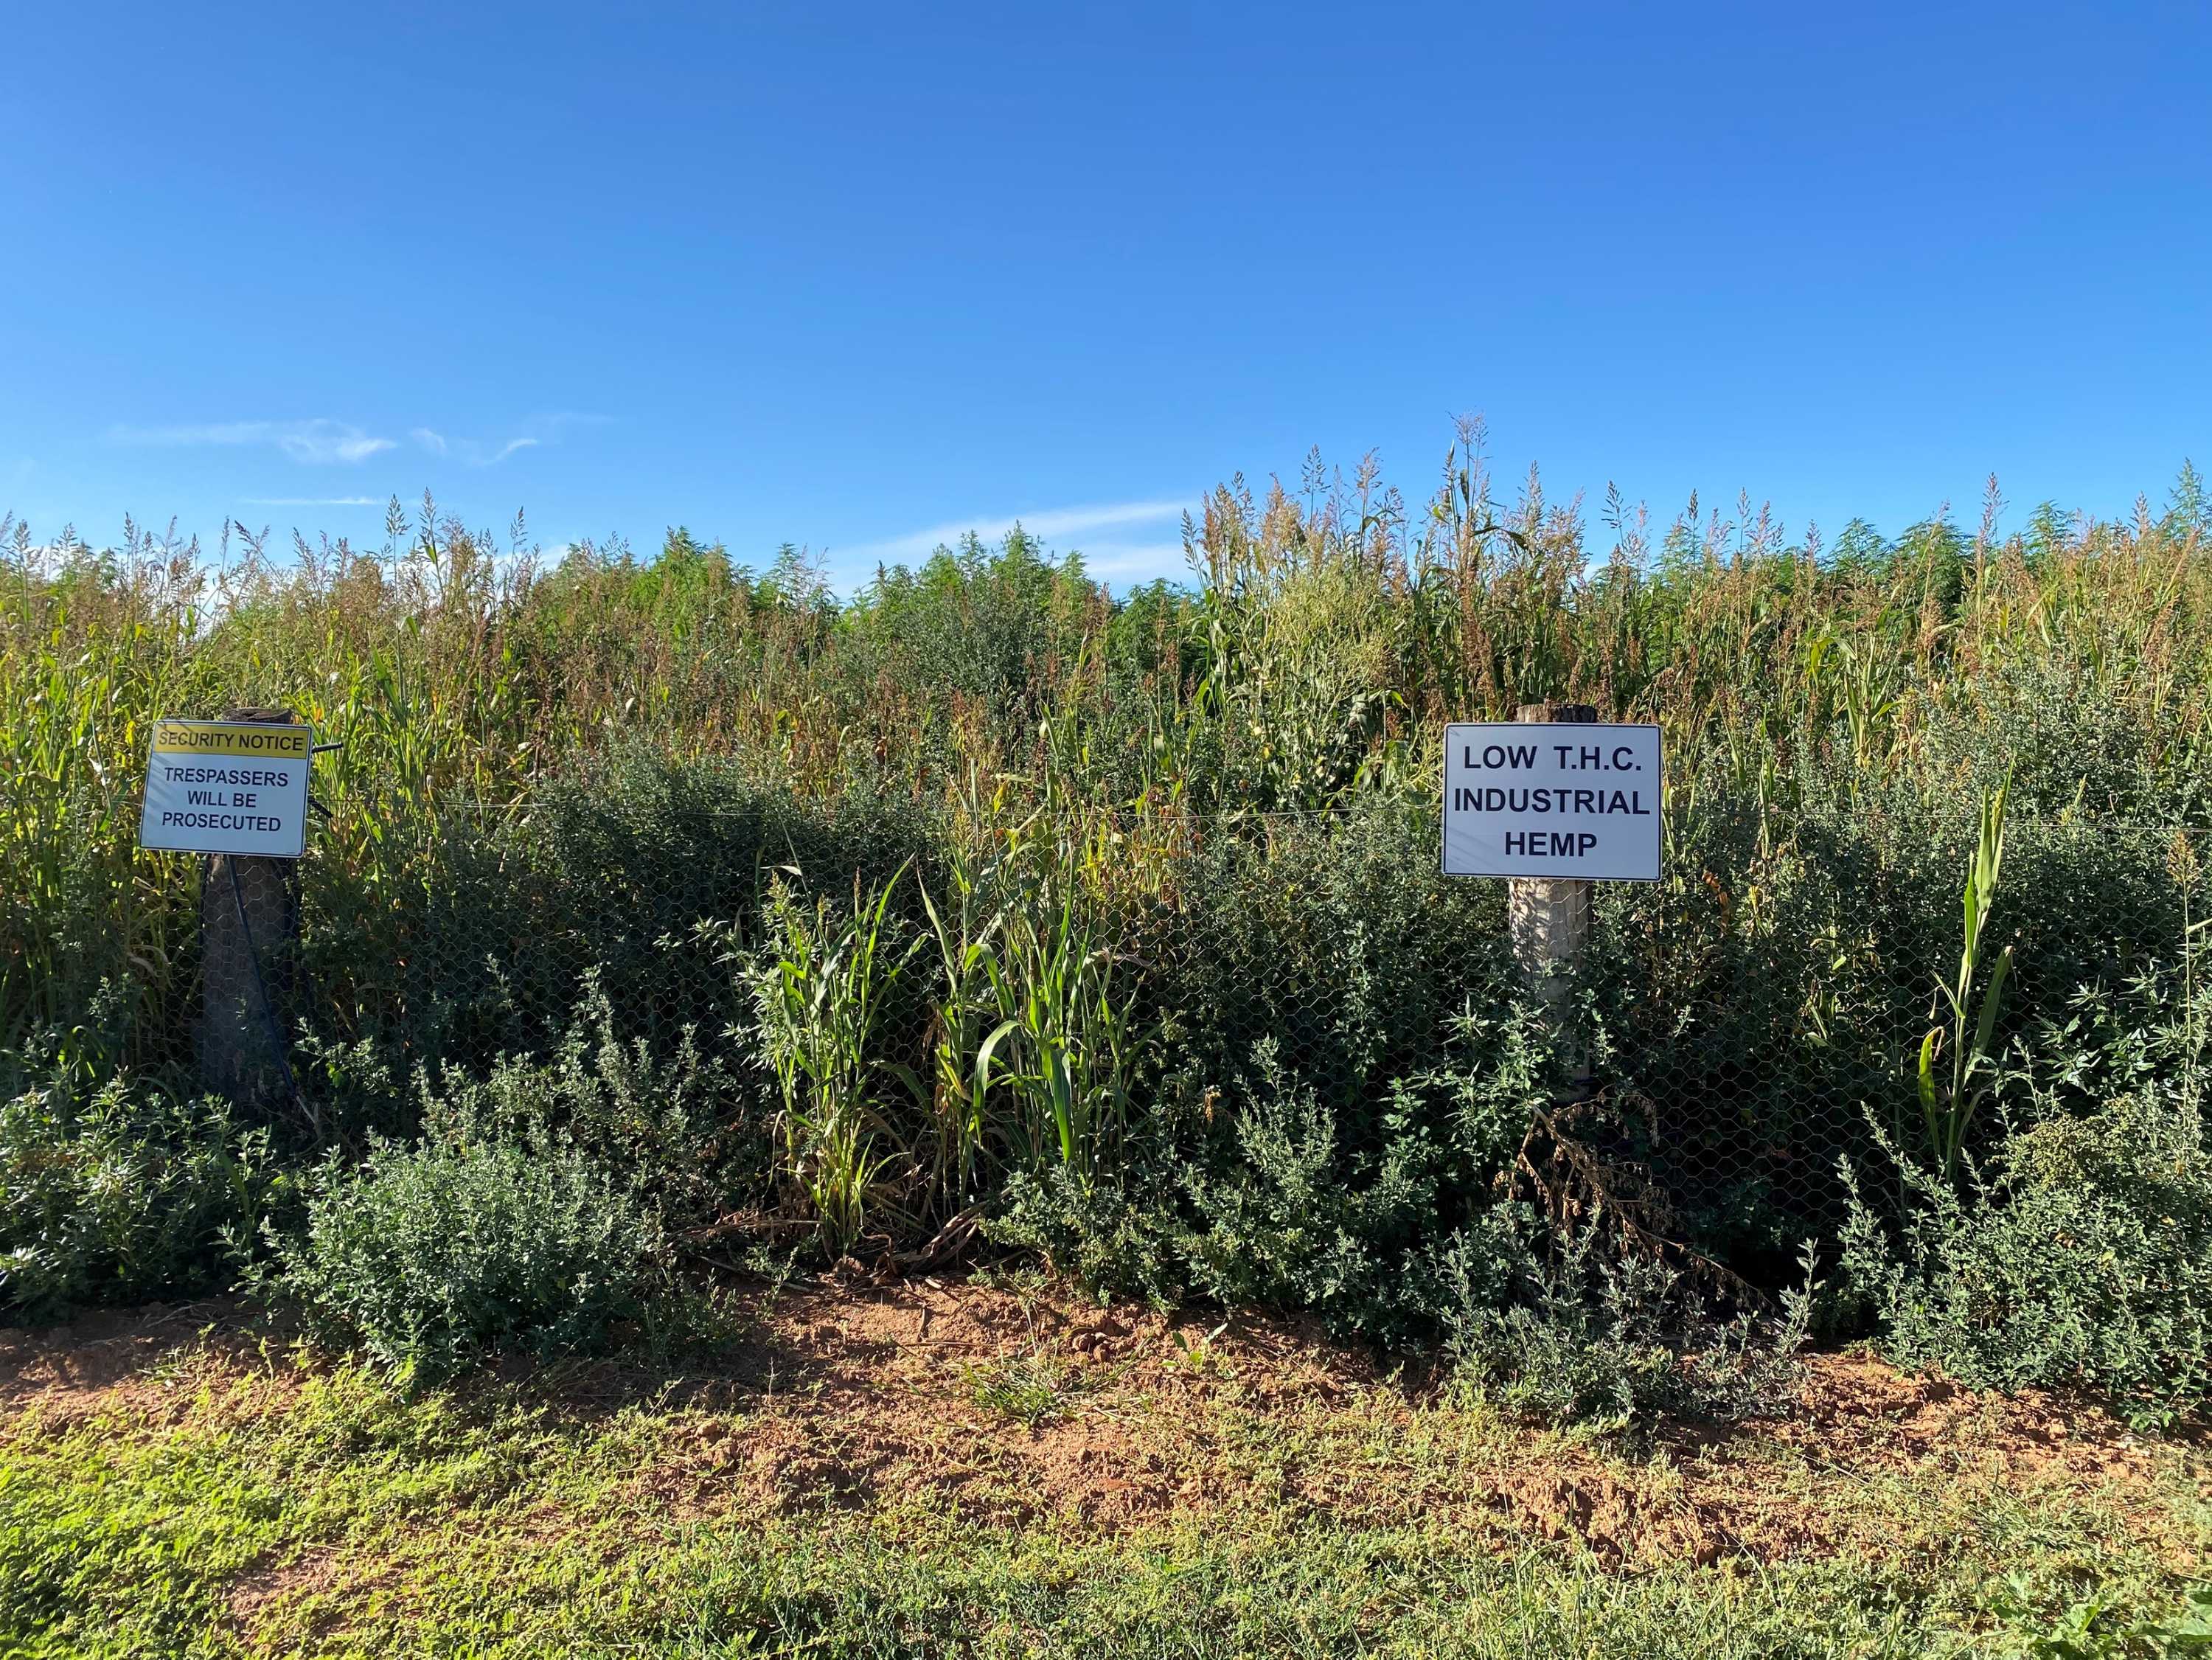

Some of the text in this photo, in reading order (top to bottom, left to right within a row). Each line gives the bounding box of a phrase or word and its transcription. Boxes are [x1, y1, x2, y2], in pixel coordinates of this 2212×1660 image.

[159, 732, 304, 751] SECURITY NOTICE
[1464, 746, 1641, 771] LOW T.H.C.
[164, 767, 288, 787] TRESPASSERS
[187, 791, 257, 808] WILL BE
[1455, 788, 1650, 815] INDUSTRIAL
[162, 811, 281, 832] PROSECUTED
[1505, 831, 1597, 857] HEMP
